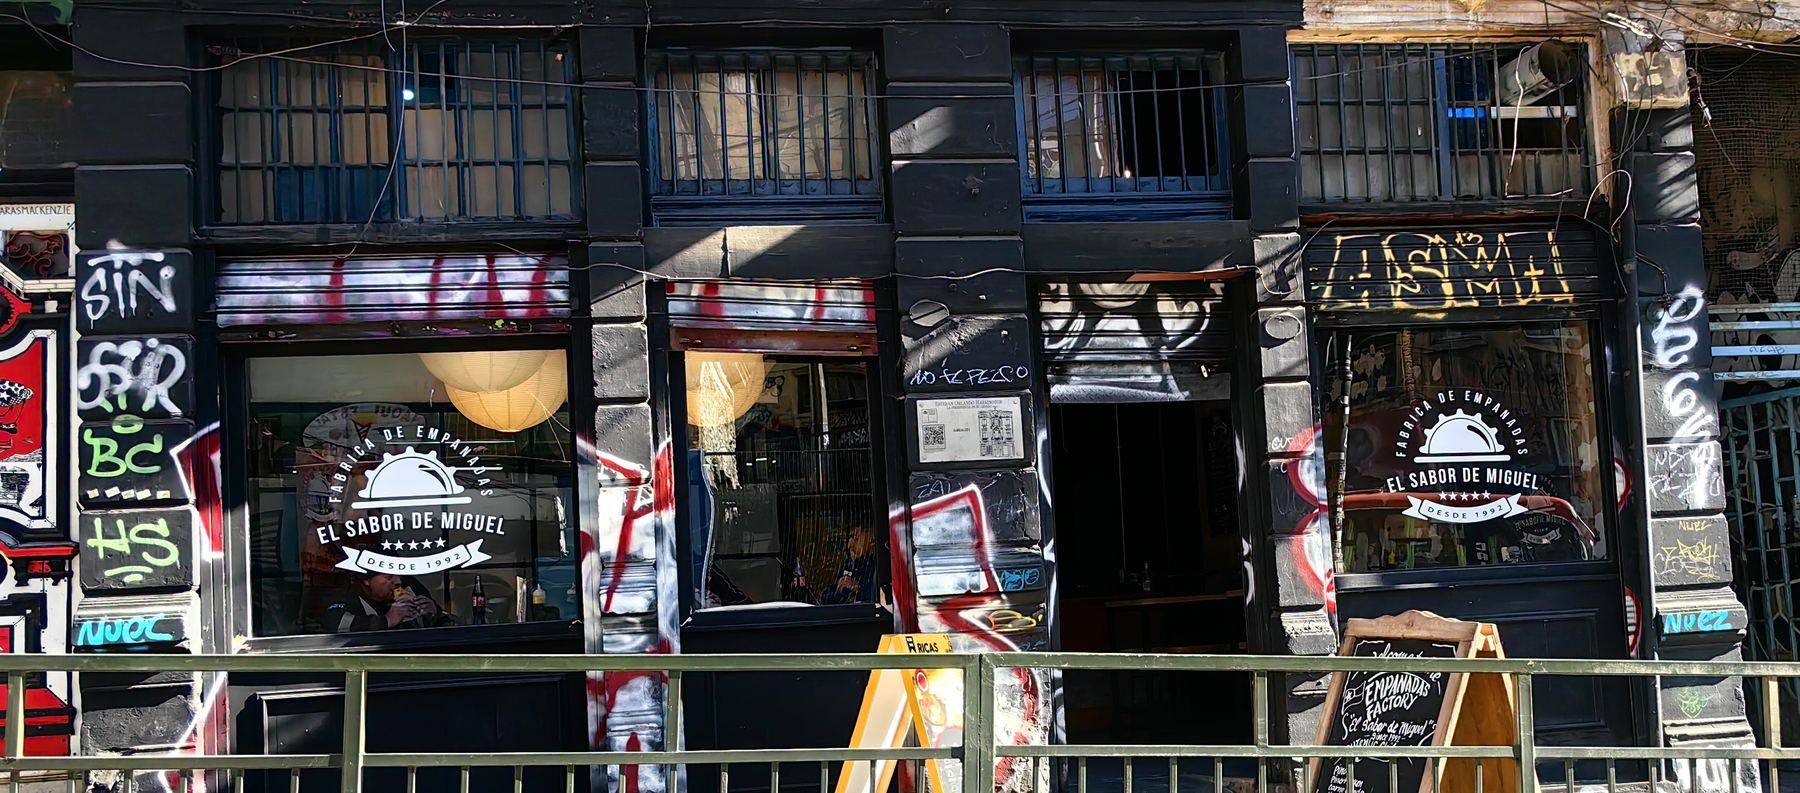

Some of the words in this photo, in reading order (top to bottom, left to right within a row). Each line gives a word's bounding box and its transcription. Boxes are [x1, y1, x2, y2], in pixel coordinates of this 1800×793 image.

[1396, 400, 1432, 457] FABRICA
[1438, 390, 1455, 403] DE
[1465, 390, 1528, 455] EMPANADAS
[329, 438, 375, 503] FABRICA
[383, 426, 404, 441] DE
[416, 425, 493, 496] EMPANADAS
[1386, 476, 1405, 493] EL
[1409, 468, 1457, 488] SABOR
[1462, 467, 1480, 483] DE
[1487, 468, 1539, 490] MIGUEL
[1427, 506, 1467, 519] DESDE
[1475, 505, 1503, 518] 1992
[316, 524, 340, 545] EL
[345, 513, 404, 538] SABOR
[412, 511, 433, 529] DE
[441, 512, 505, 535] MIGUEL
[367, 557, 416, 571] DESDE
[426, 552, 461, 569] 1992
[917, 643, 939, 653] RICAS
[1366, 674, 1430, 705] EMPANADAS
[1366, 692, 1418, 721] FACTORY
